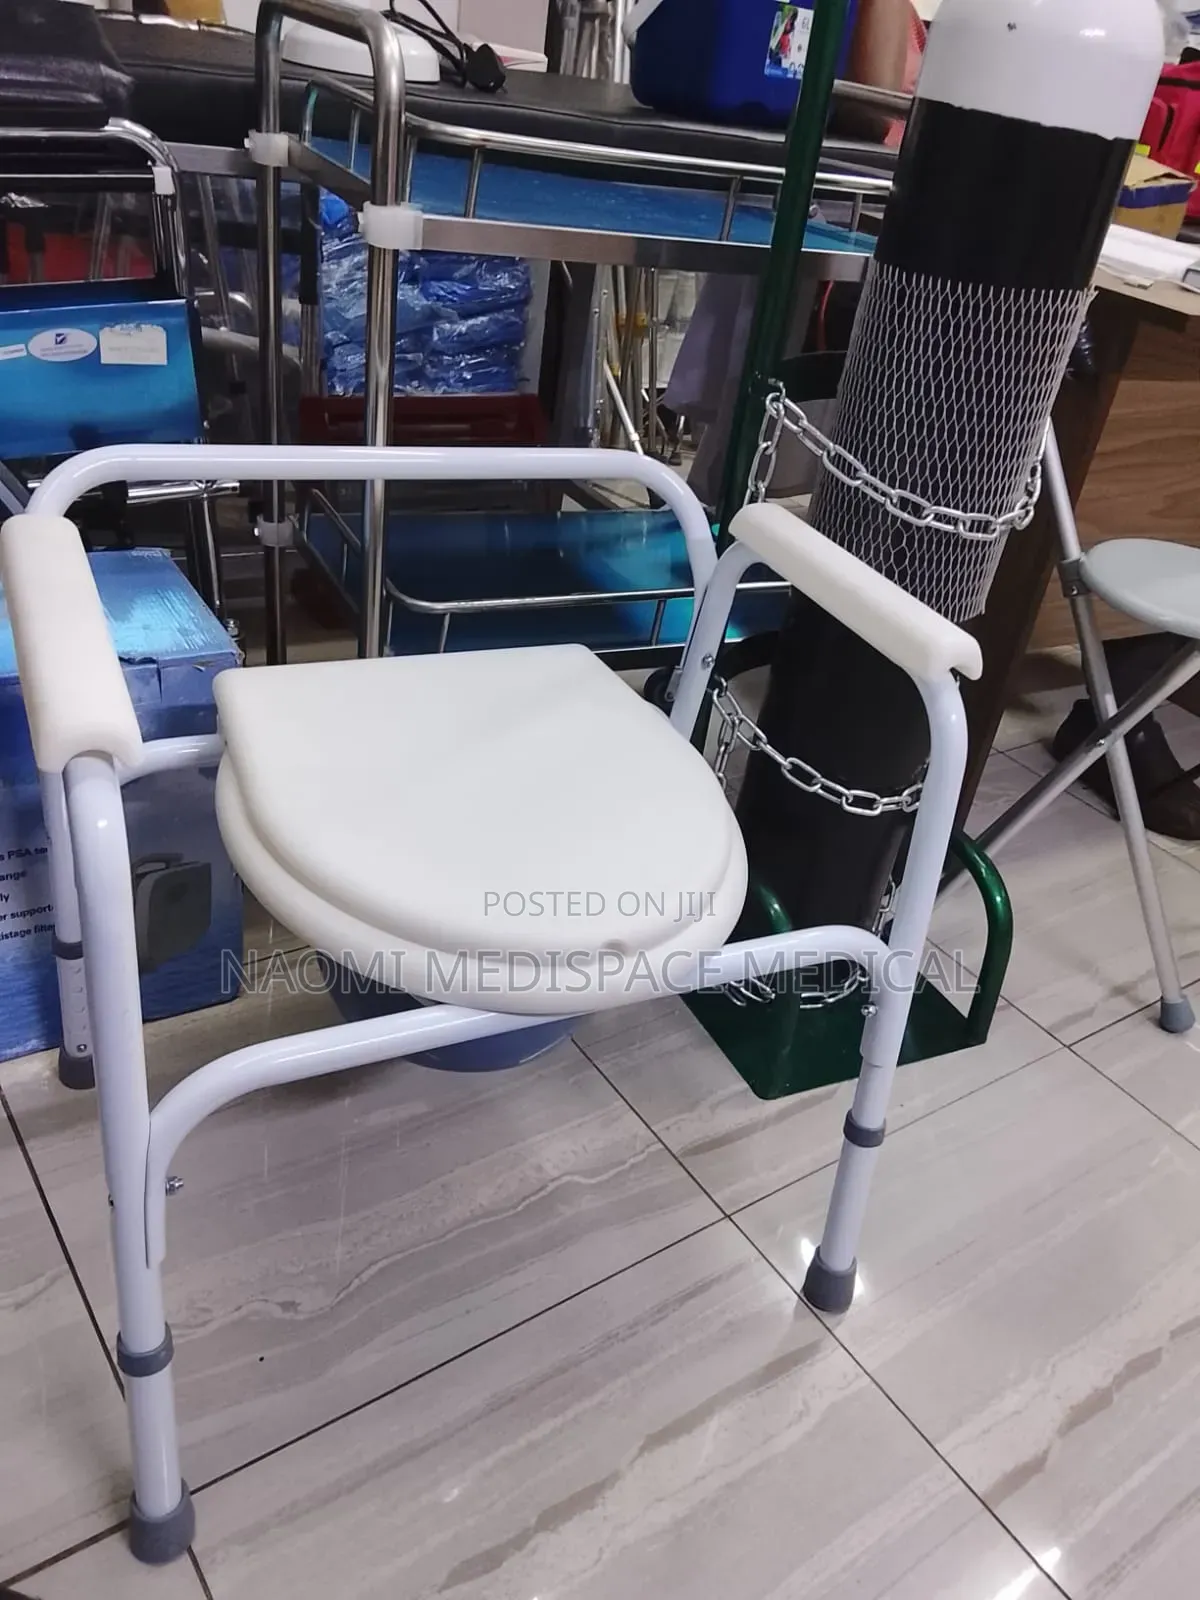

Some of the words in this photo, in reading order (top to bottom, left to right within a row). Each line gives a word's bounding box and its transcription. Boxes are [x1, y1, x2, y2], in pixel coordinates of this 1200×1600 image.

[7, 847, 33, 860] PSA
[0, 870, 28, 882] ange
[0, 892, 10, 904] ly
[0, 927, 32, 942] istage
